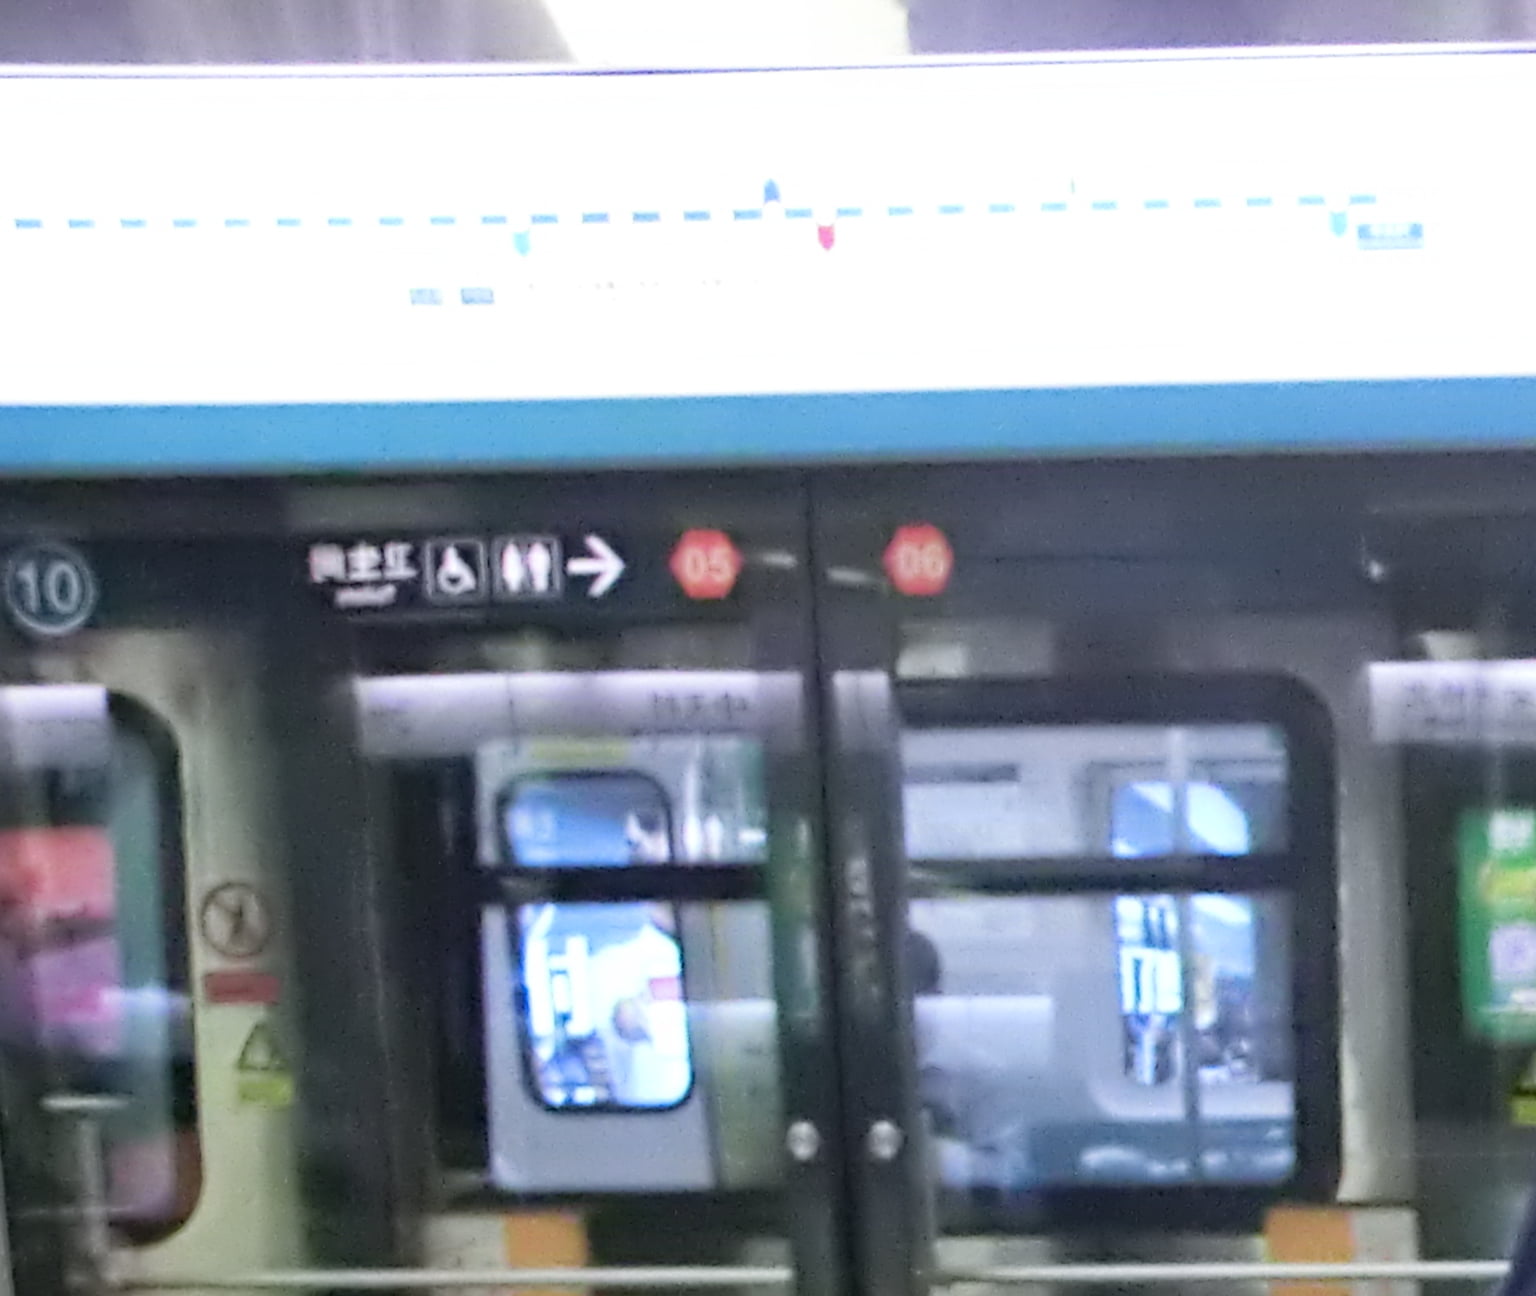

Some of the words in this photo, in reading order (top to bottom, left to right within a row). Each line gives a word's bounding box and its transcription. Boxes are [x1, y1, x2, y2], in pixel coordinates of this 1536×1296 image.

[683, 545, 733, 583] 05
[895, 543, 947, 580] 06
[15, 561, 79, 614] 10
